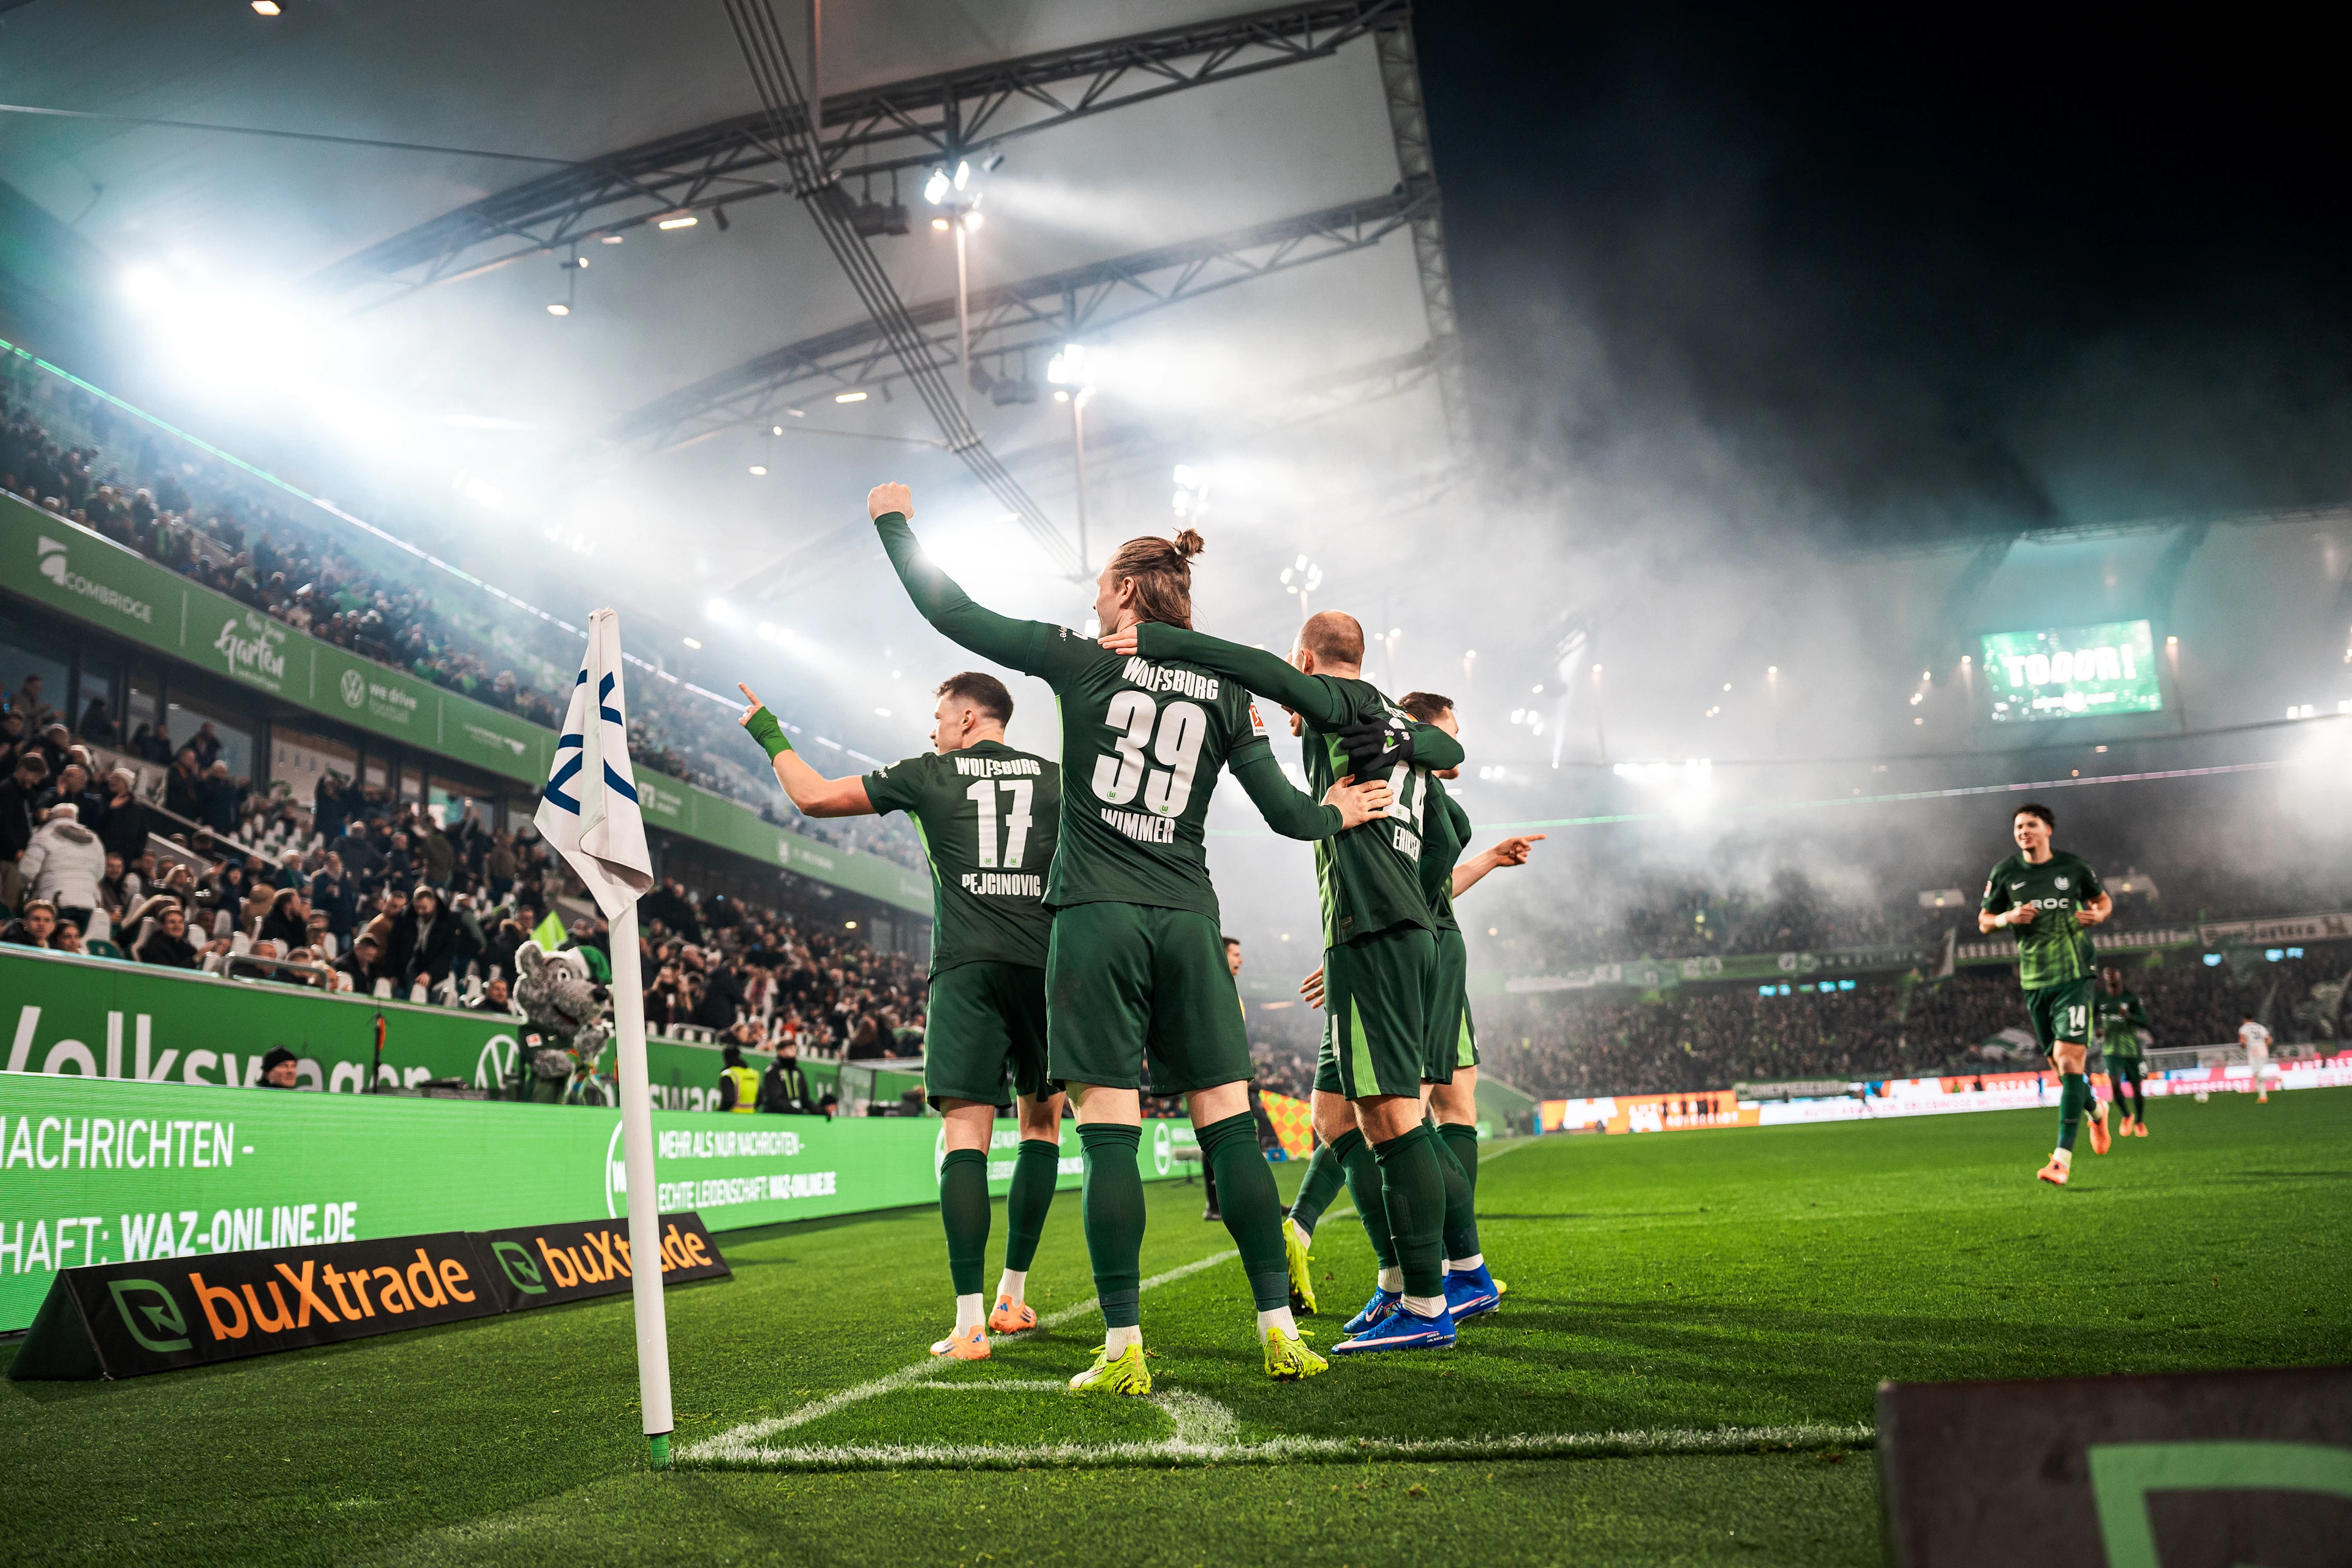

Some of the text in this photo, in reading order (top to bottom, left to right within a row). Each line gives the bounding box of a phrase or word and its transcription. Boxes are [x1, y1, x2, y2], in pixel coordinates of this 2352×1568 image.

[66, 572, 152, 624] COMBRIDGE
[1121, 655, 1219, 700] WOLFSBURG
[954, 756, 1042, 778] WOLFSBURG
[1091, 690, 1207, 818] 39
[967, 779, 1034, 869] 17
[1101, 807, 1176, 845] WIMMER
[1392, 824, 1422, 863] ERIKSEN
[962, 872, 1041, 897] PEJCINOVIC
[2068, 1005, 2086, 1029] 14
[658, 1131, 692, 1158] MEHR
[692, 1131, 714, 1158] ALS
[714, 1131, 736, 1157] NUR
[658, 1181, 695, 1212] ECHTE
[121, 1201, 357, 1262] WAZ-ONLINE.DE
[535, 1223, 713, 1288] buXtde
[188, 1248, 477, 1341] buXtrade
